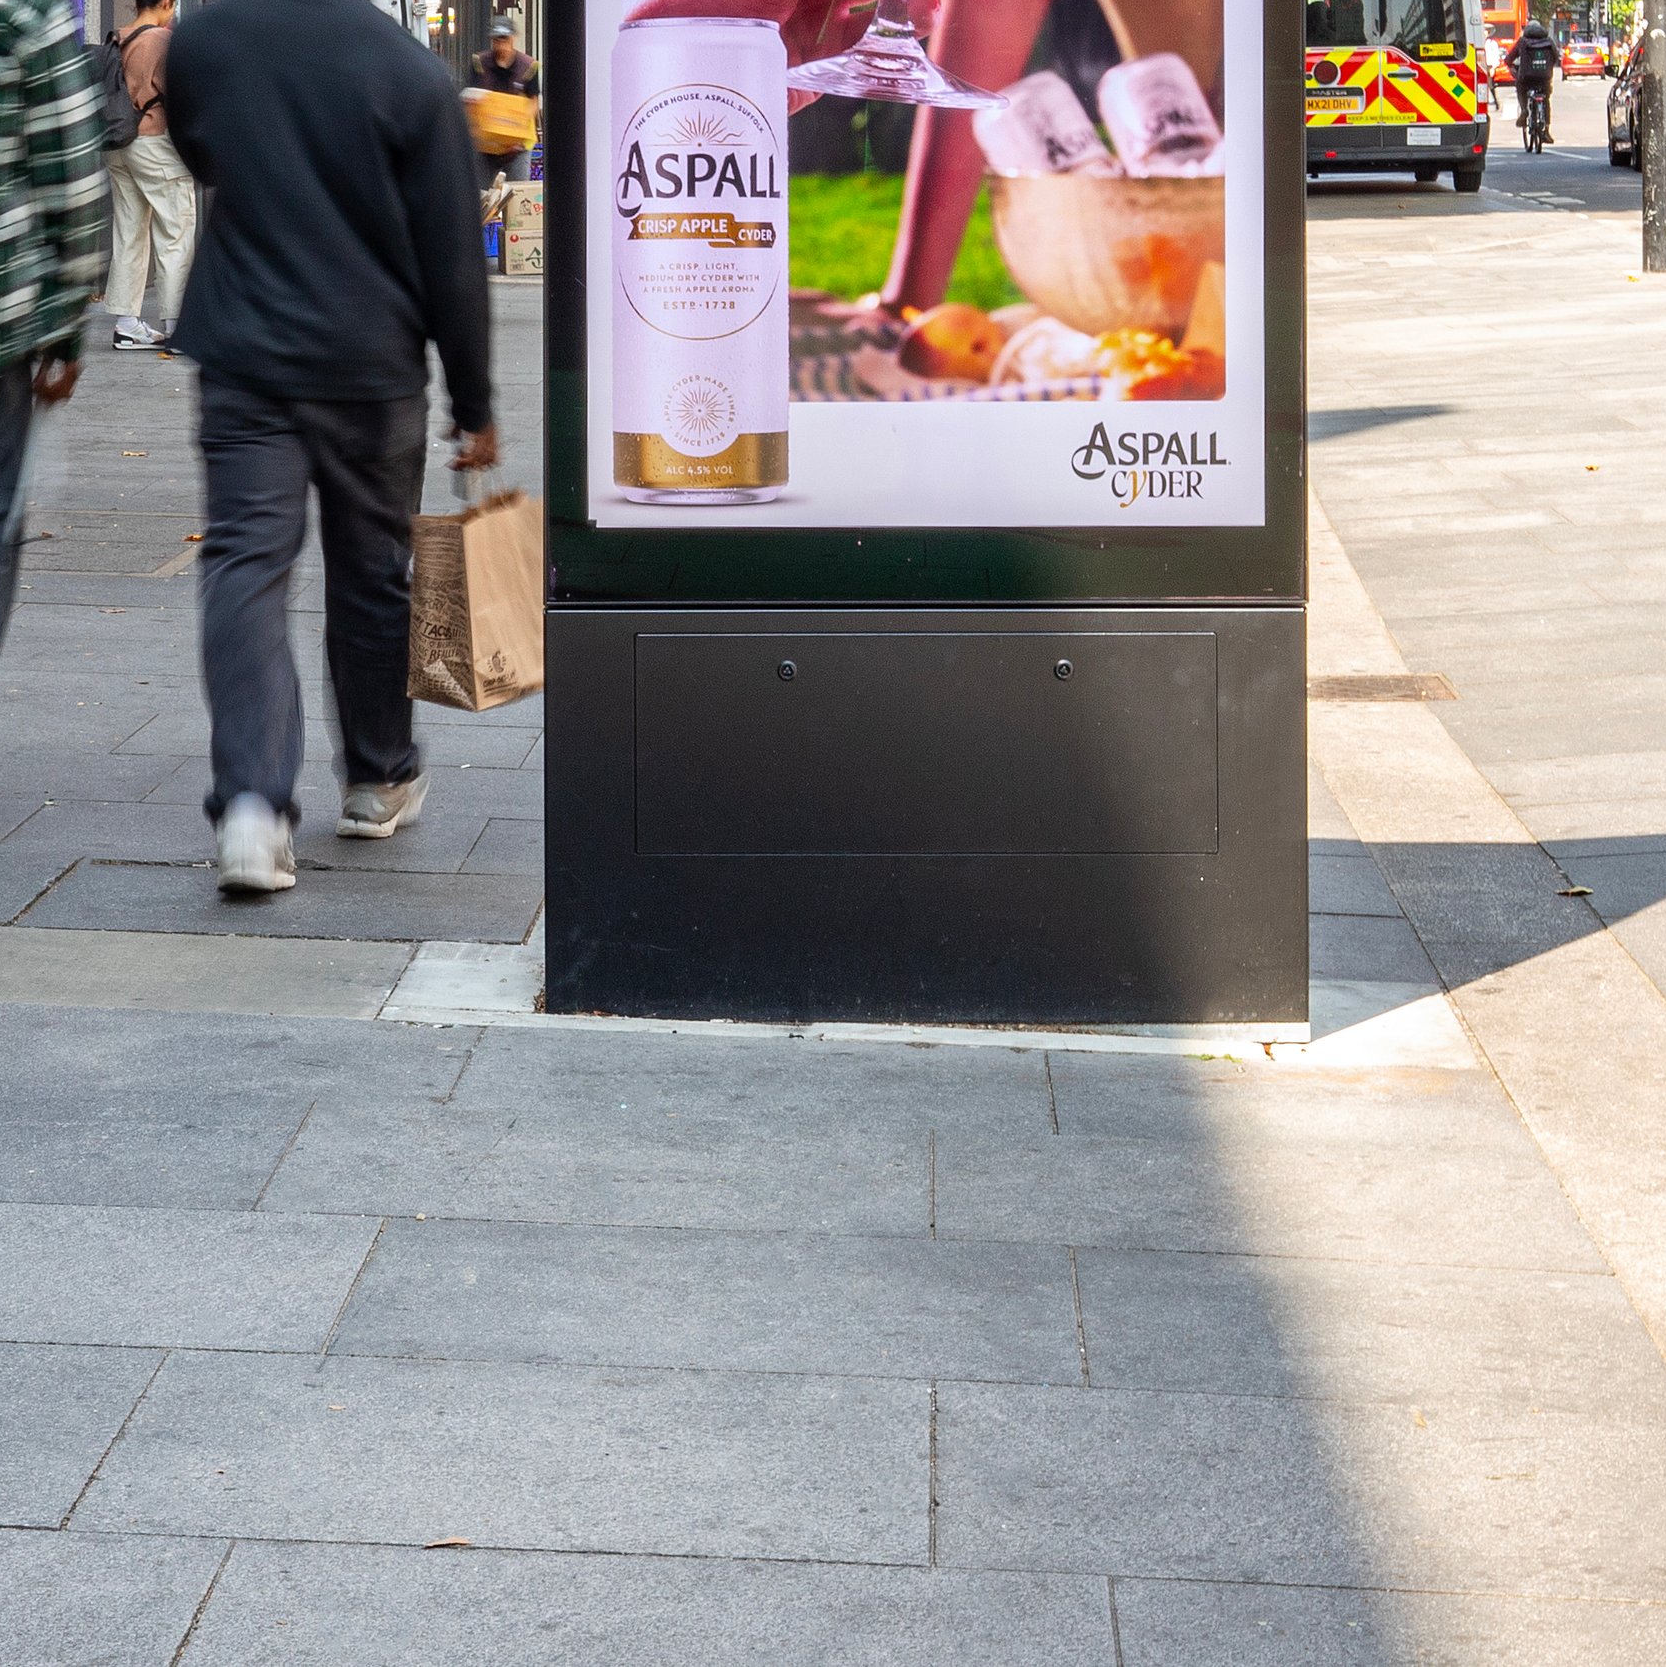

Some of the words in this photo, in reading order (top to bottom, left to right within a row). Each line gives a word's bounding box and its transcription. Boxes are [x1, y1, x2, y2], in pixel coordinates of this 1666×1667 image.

[1333, 98, 1352, 109] DHV
[635, 117, 647, 132] THE
[646, 100, 670, 120] CYDER
[737, 105, 765, 134] SUFFOLK
[616, 140, 781, 218] ASPALL
[638, 219, 677, 234] CRISP
[680, 218, 728, 234] APPLE
[738, 228, 773, 242] CYDER
[638, 274, 675, 282] MEDIUM
[677, 274, 698, 282] DRY
[701, 274, 734, 282] CYDER
[736, 274, 760, 282] WITH
[1071, 421, 1227, 480] ASPALL
[665, 466, 685, 475] ALC
[687, 466, 711, 475] 4.5%
[713, 466, 734, 475] VOL
